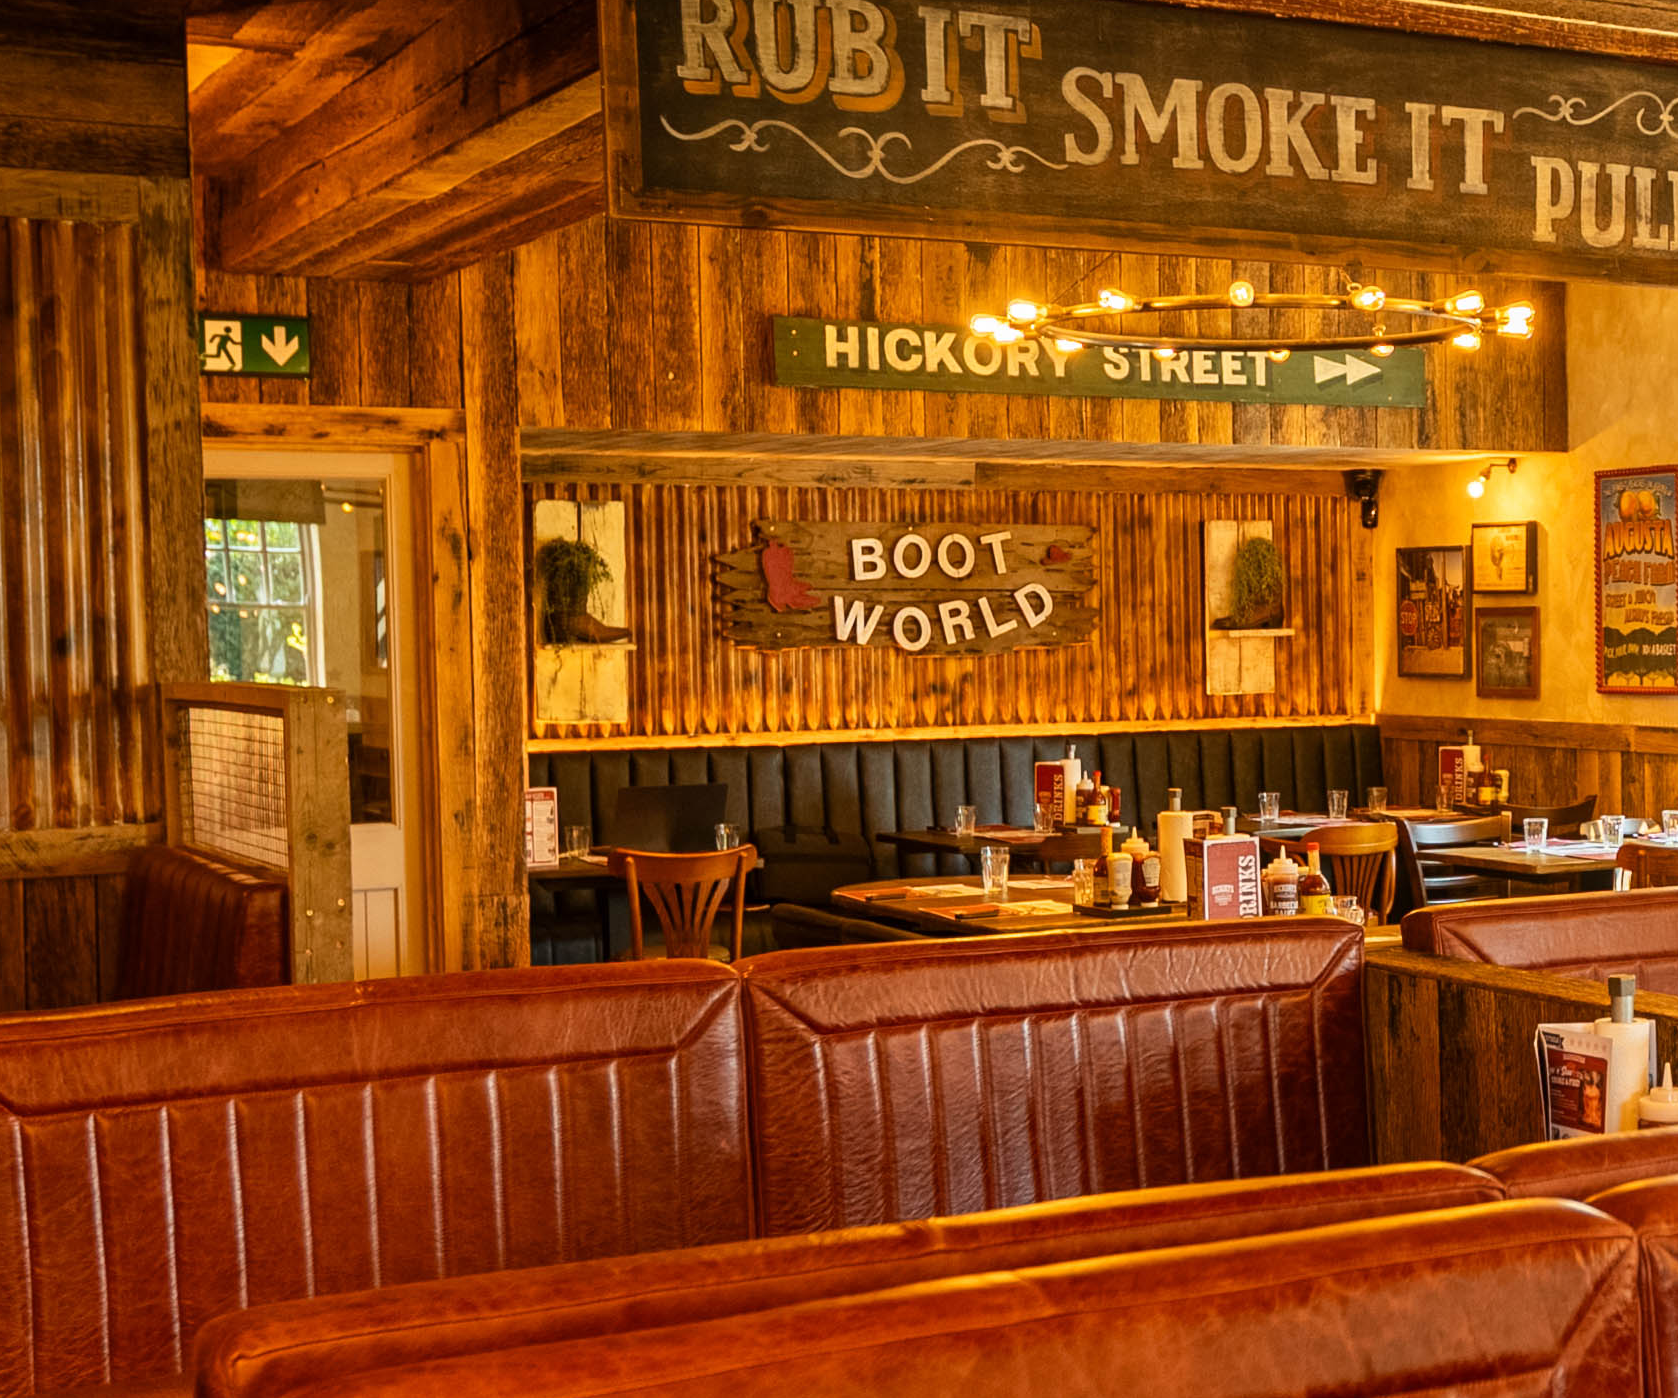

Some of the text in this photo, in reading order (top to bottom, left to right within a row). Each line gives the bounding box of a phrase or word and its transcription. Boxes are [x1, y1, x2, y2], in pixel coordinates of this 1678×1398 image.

[1061, 64, 1382, 187] SMOKE
[1405, 100, 1505, 197] IT
[824, 324, 1272, 388] HICKORY STREET
[851, 530, 1015, 584] BOOT
[1603, 519, 1675, 561] AUGUSTA
[833, 581, 1055, 652] WORLD
[1055, 774, 1064, 822] DRINKS
[1454, 757, 1464, 803] DRINKS
[1238, 855, 1257, 918] RINKS
